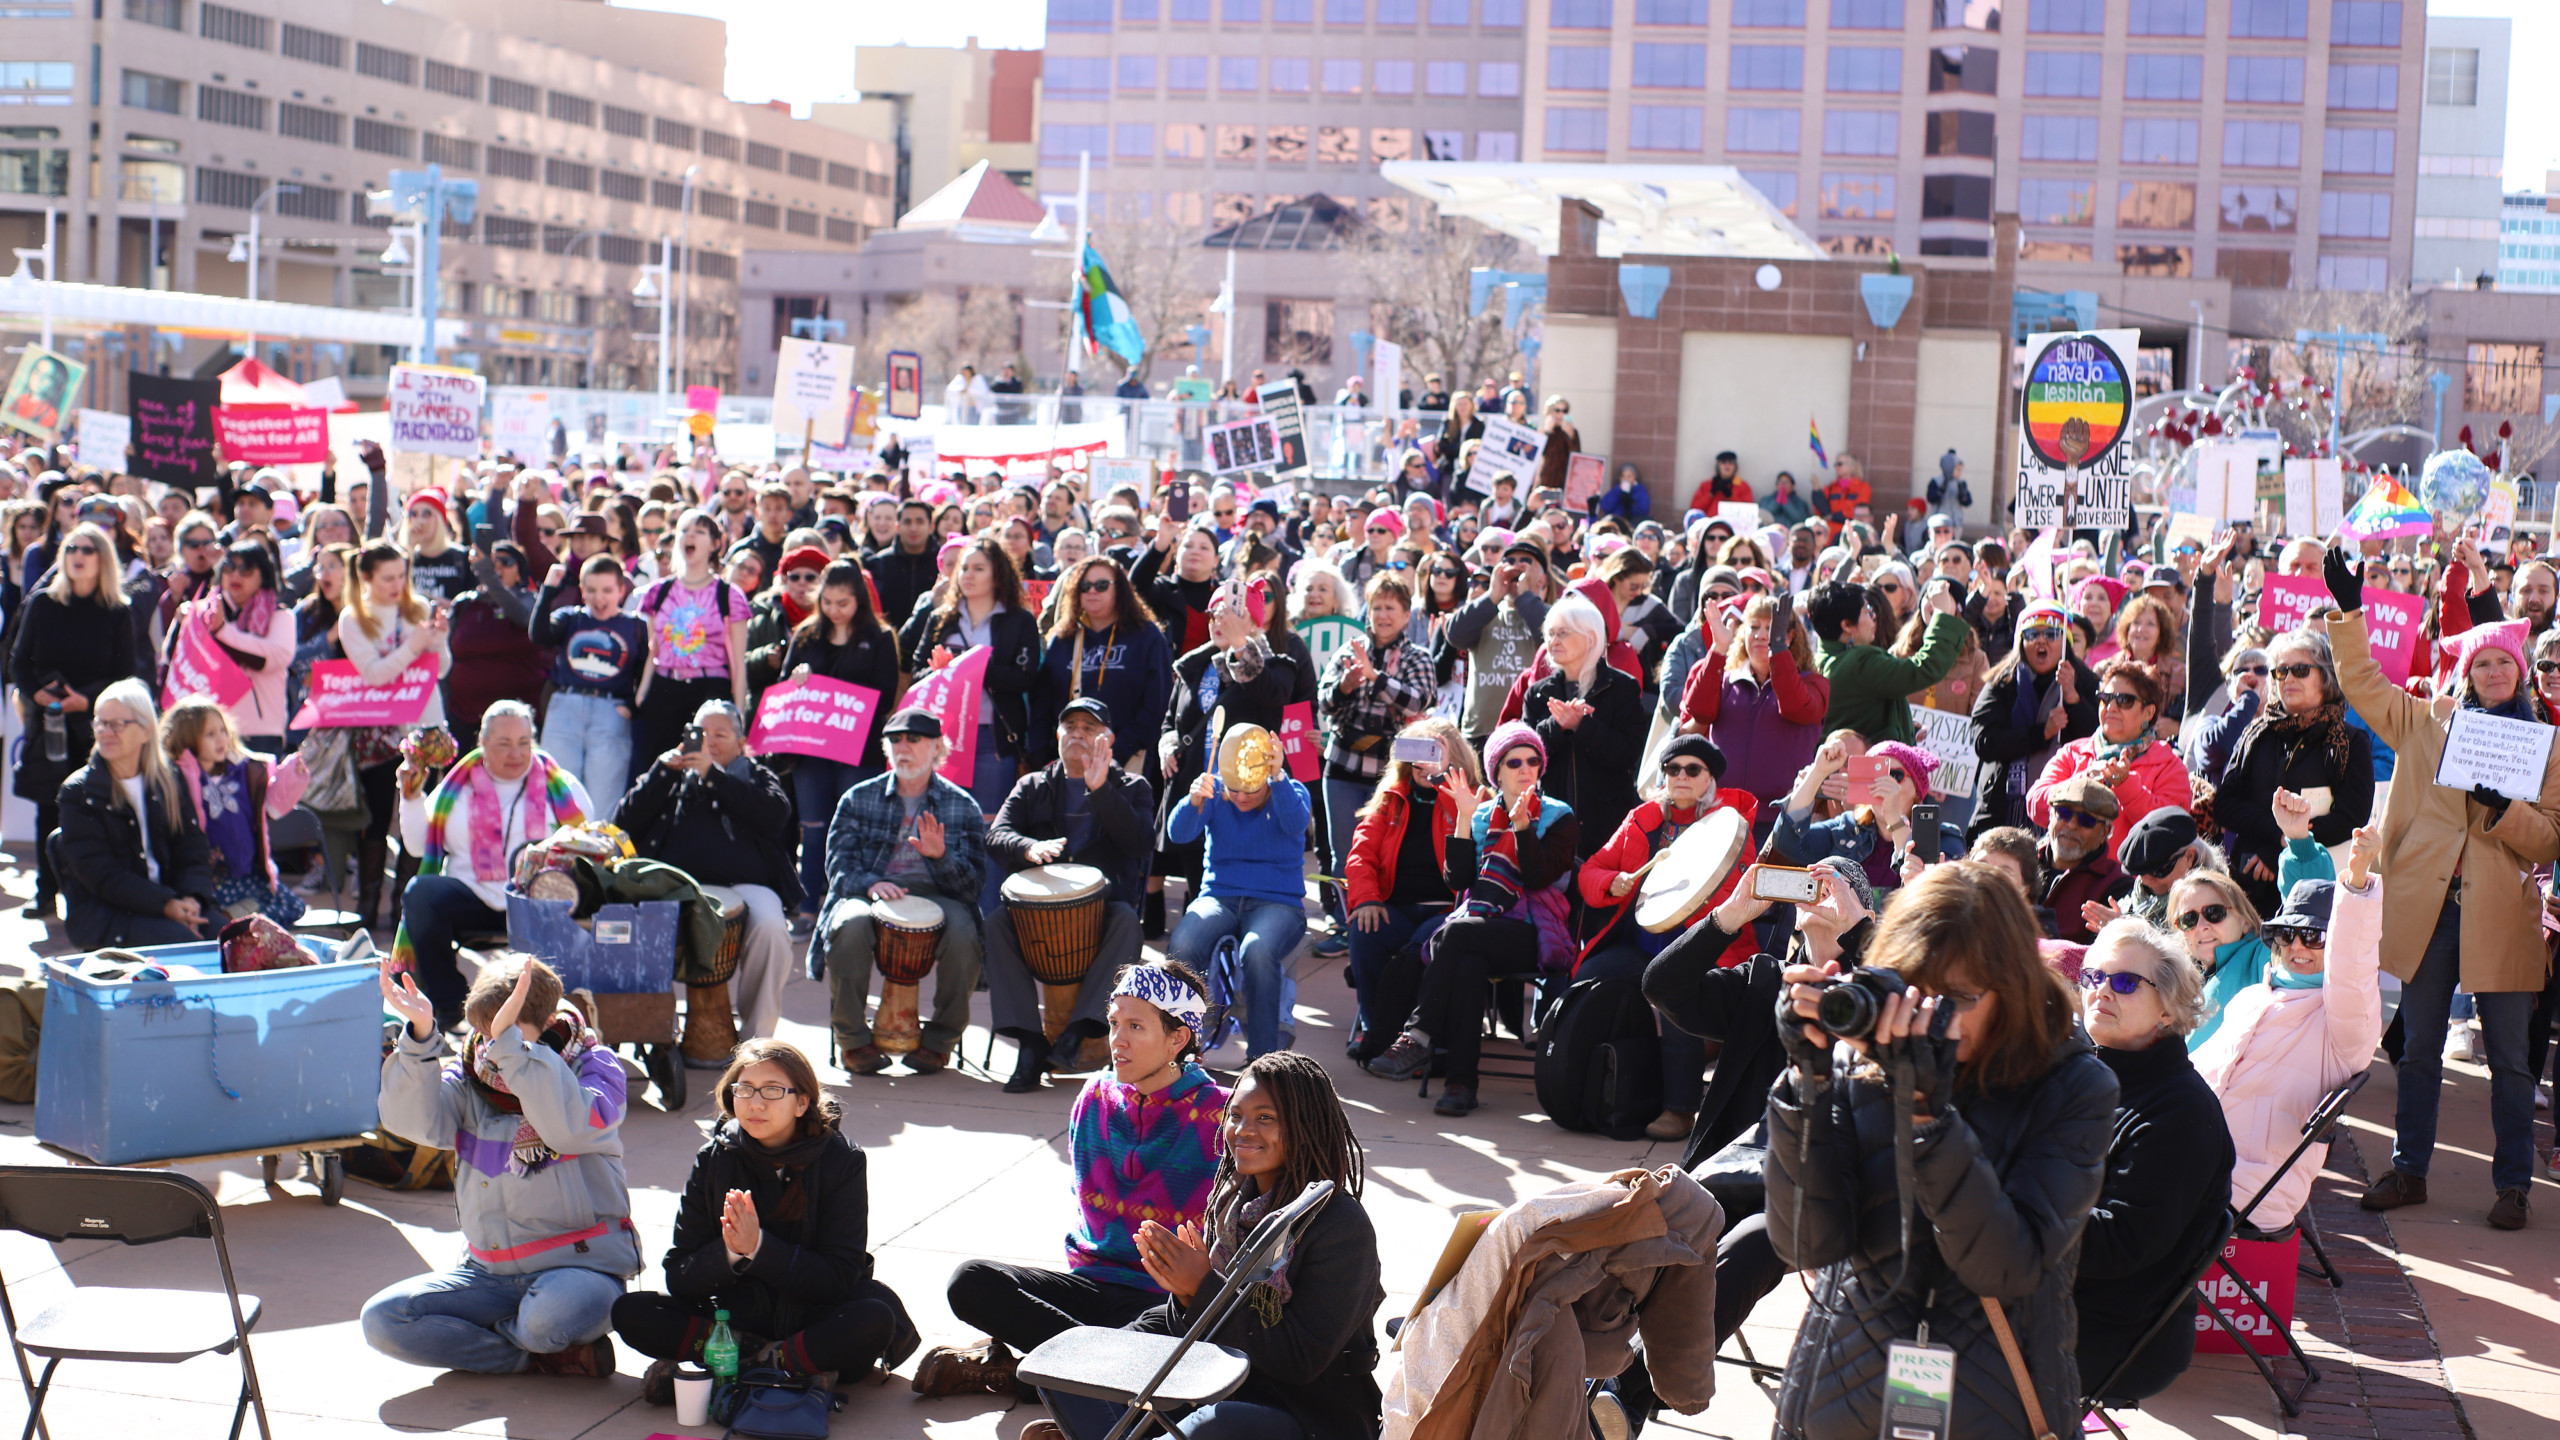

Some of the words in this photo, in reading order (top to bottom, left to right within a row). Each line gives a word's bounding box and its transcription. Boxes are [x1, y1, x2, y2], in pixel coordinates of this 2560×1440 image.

[2056, 342, 2095, 363] BLIND
[422, 375, 476, 393] STAND
[2048, 363, 2104, 386] navajo
[416, 391, 452, 405] WITH
[2044, 383, 2106, 403] lesbian
[219, 416, 293, 434] Together
[293, 414, 321, 430] We
[396, 403, 471, 425] PLANNED
[223, 431, 267, 449] Fight
[267, 431, 293, 446] for
[295, 428, 320, 445] All
[394, 420, 475, 443] PARENTHOOD
[2090, 441, 2132, 477] LOVE
[2018, 471, 2056, 508] POWER
[2085, 476, 2130, 510] UNITE
[2026, 509, 2054, 526] RISE
[2077, 510, 2130, 526] DIVERSITY
[2374, 602, 2408, 626] We
[2369, 628, 2400, 650] All
[401, 667, 431, 684] We
[364, 687, 392, 703] for
[392, 685, 423, 701] All
[833, 691, 866, 713] We
[794, 705, 825, 724] for
[825, 711, 857, 732] All
[2462, 714, 2498, 727] Answer:
[2499, 720, 2526, 732] When
[2526, 726, 2545, 736] you
[2457, 734, 2471, 743] for
[2472, 738, 2492, 747] that
[2492, 741, 2519, 753] which
[2520, 745, 2537, 755] has
[2464, 725, 2486, 736] have
[2500, 734, 2536, 746] answer,
[2451, 754, 2474, 766] have
[2474, 761, 2487, 769] no
[2488, 763, 2521, 776] answer
[2522, 768, 2532, 776] to
[2460, 747, 2473, 755] no
[2473, 750, 2509, 763] answer,
[2511, 754, 2529, 766] You
[2470, 771, 2490, 780] give
[1892, 1353, 1953, 1368] PRESS
[1898, 1367, 1943, 1380] PASS
